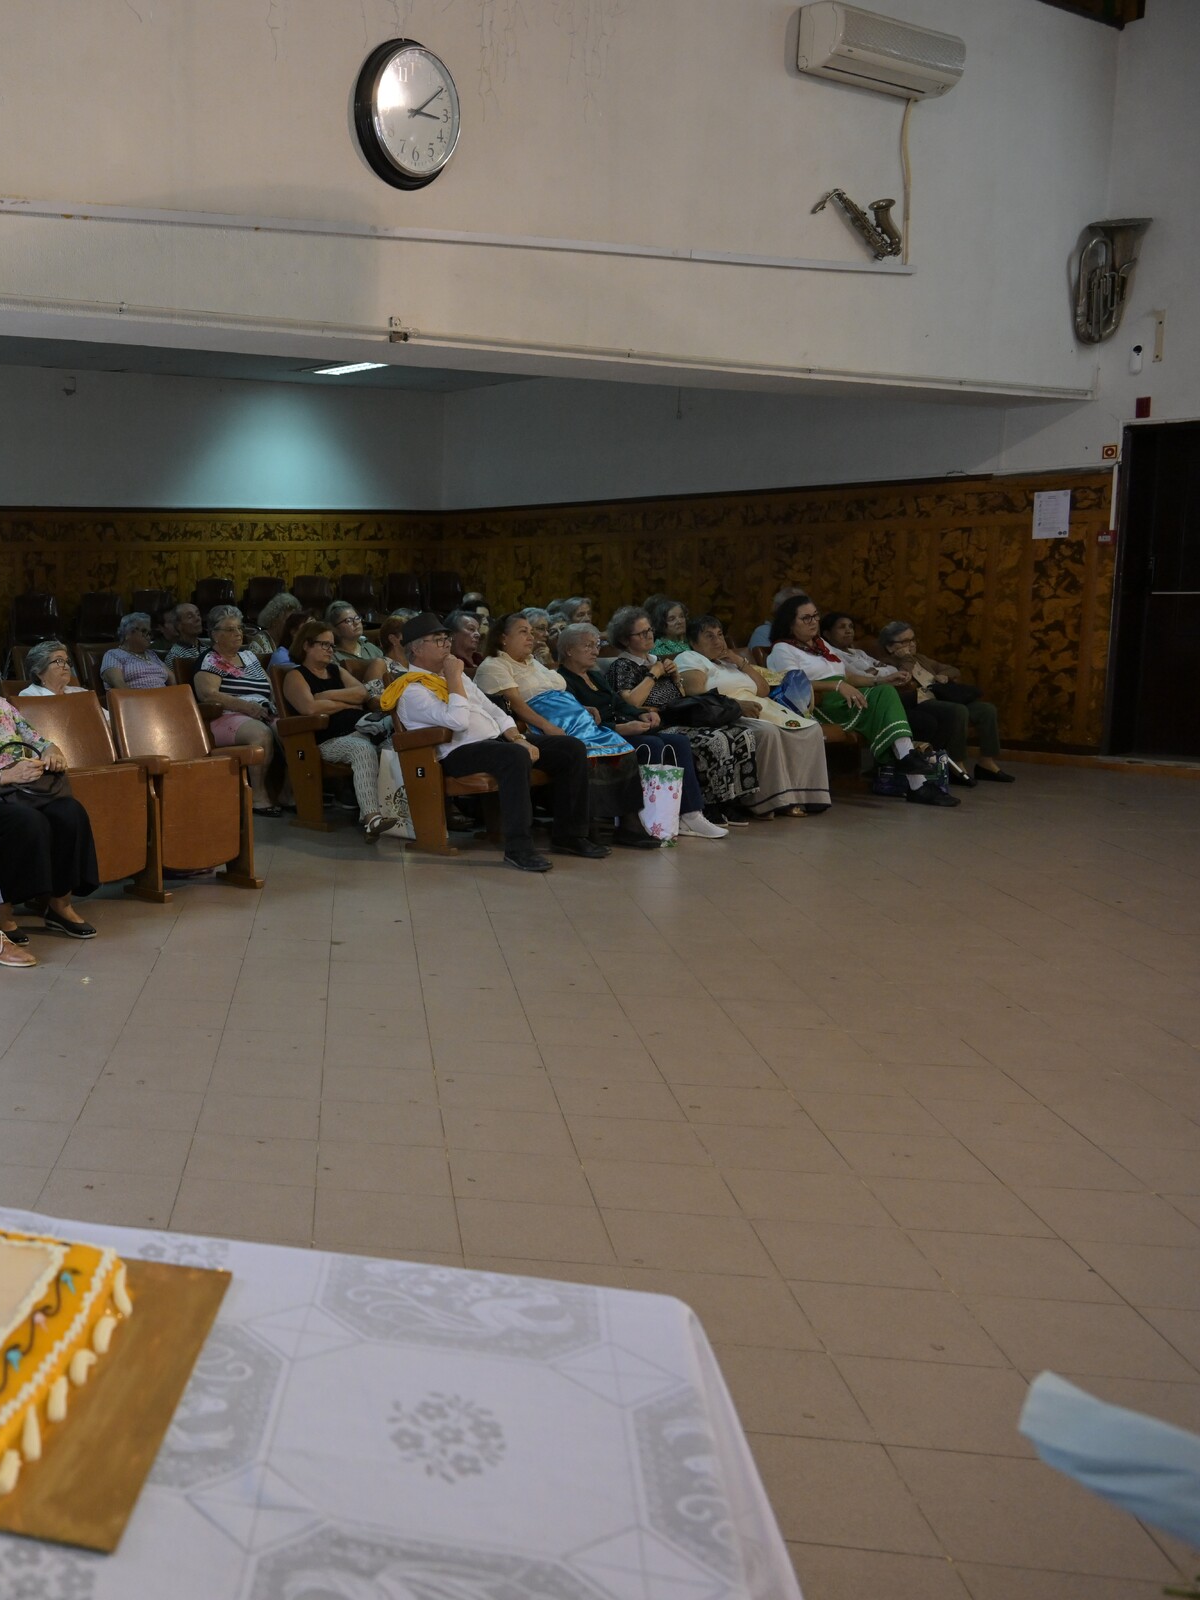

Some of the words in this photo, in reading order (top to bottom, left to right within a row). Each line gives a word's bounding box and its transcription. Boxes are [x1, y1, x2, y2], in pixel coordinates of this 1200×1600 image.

[399, 66, 408, 82] 11
[442, 109, 449, 123] 3
[436, 128, 443, 142] 4
[399, 139, 406, 153] 7
[427, 142, 434, 157] 5
[412, 146, 420, 161] 6
[417, 767, 422, 777] E
